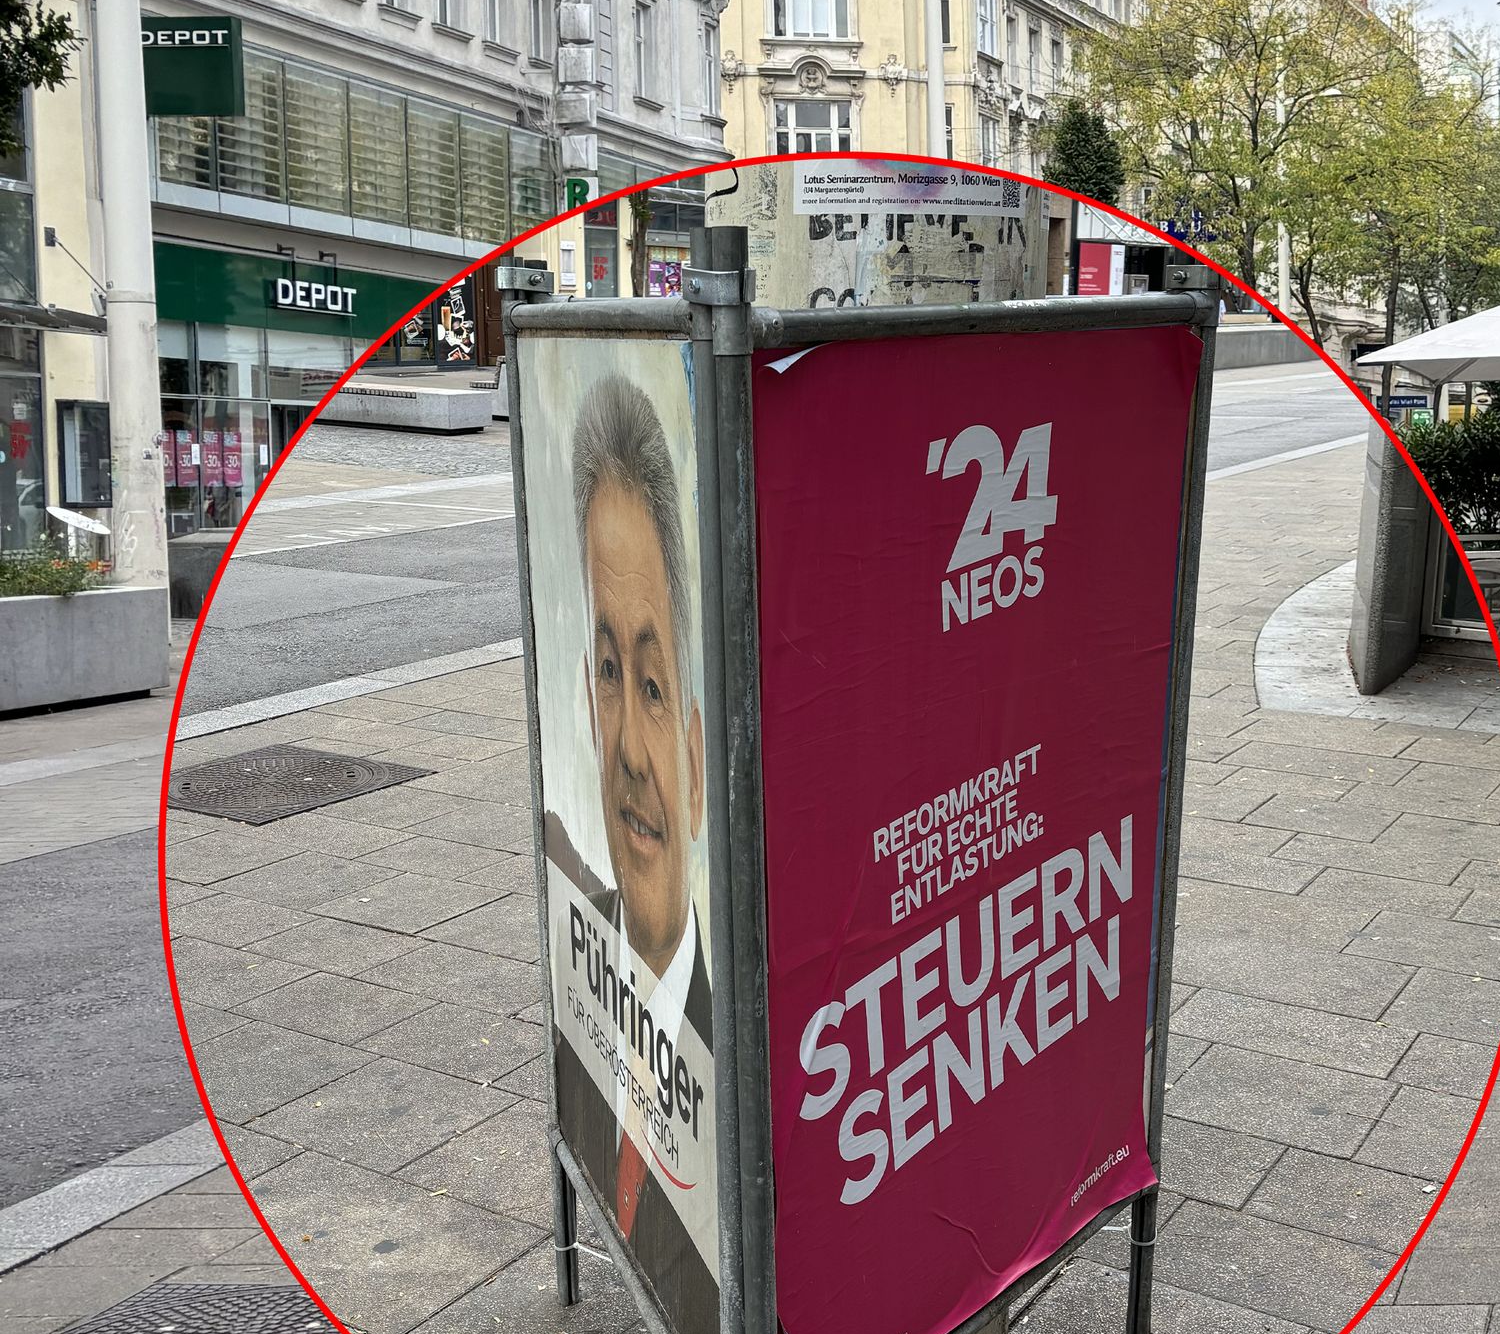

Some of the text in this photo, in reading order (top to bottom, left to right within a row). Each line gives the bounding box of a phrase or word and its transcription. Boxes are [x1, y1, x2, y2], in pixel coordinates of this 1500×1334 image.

[141, 29, 229, 46] DEPOT
[804, 173, 1001, 187] Lotus Seminarzentrum, Morizgasse 9, 1060 Wien
[818, 197, 857, 205] information
[872, 197, 910, 206] registration
[276, 277, 357, 313] DEPOT
[941, 545, 1045, 633] NEOS
[873, 743, 1042, 863] REFORMKRAFT
[897, 788, 1018, 885] FÜR ECHTE
[890, 812, 1044, 925] ENTLASTUNG:
[798, 813, 1133, 1122] STEUERN
[569, 900, 704, 1143] Pühringer
[838, 913, 1121, 1206] SENKEN
[567, 984, 679, 1171] FÜR OBERÖSTERREICH
[1069, 1144, 1130, 1207] reformkraft.eu
